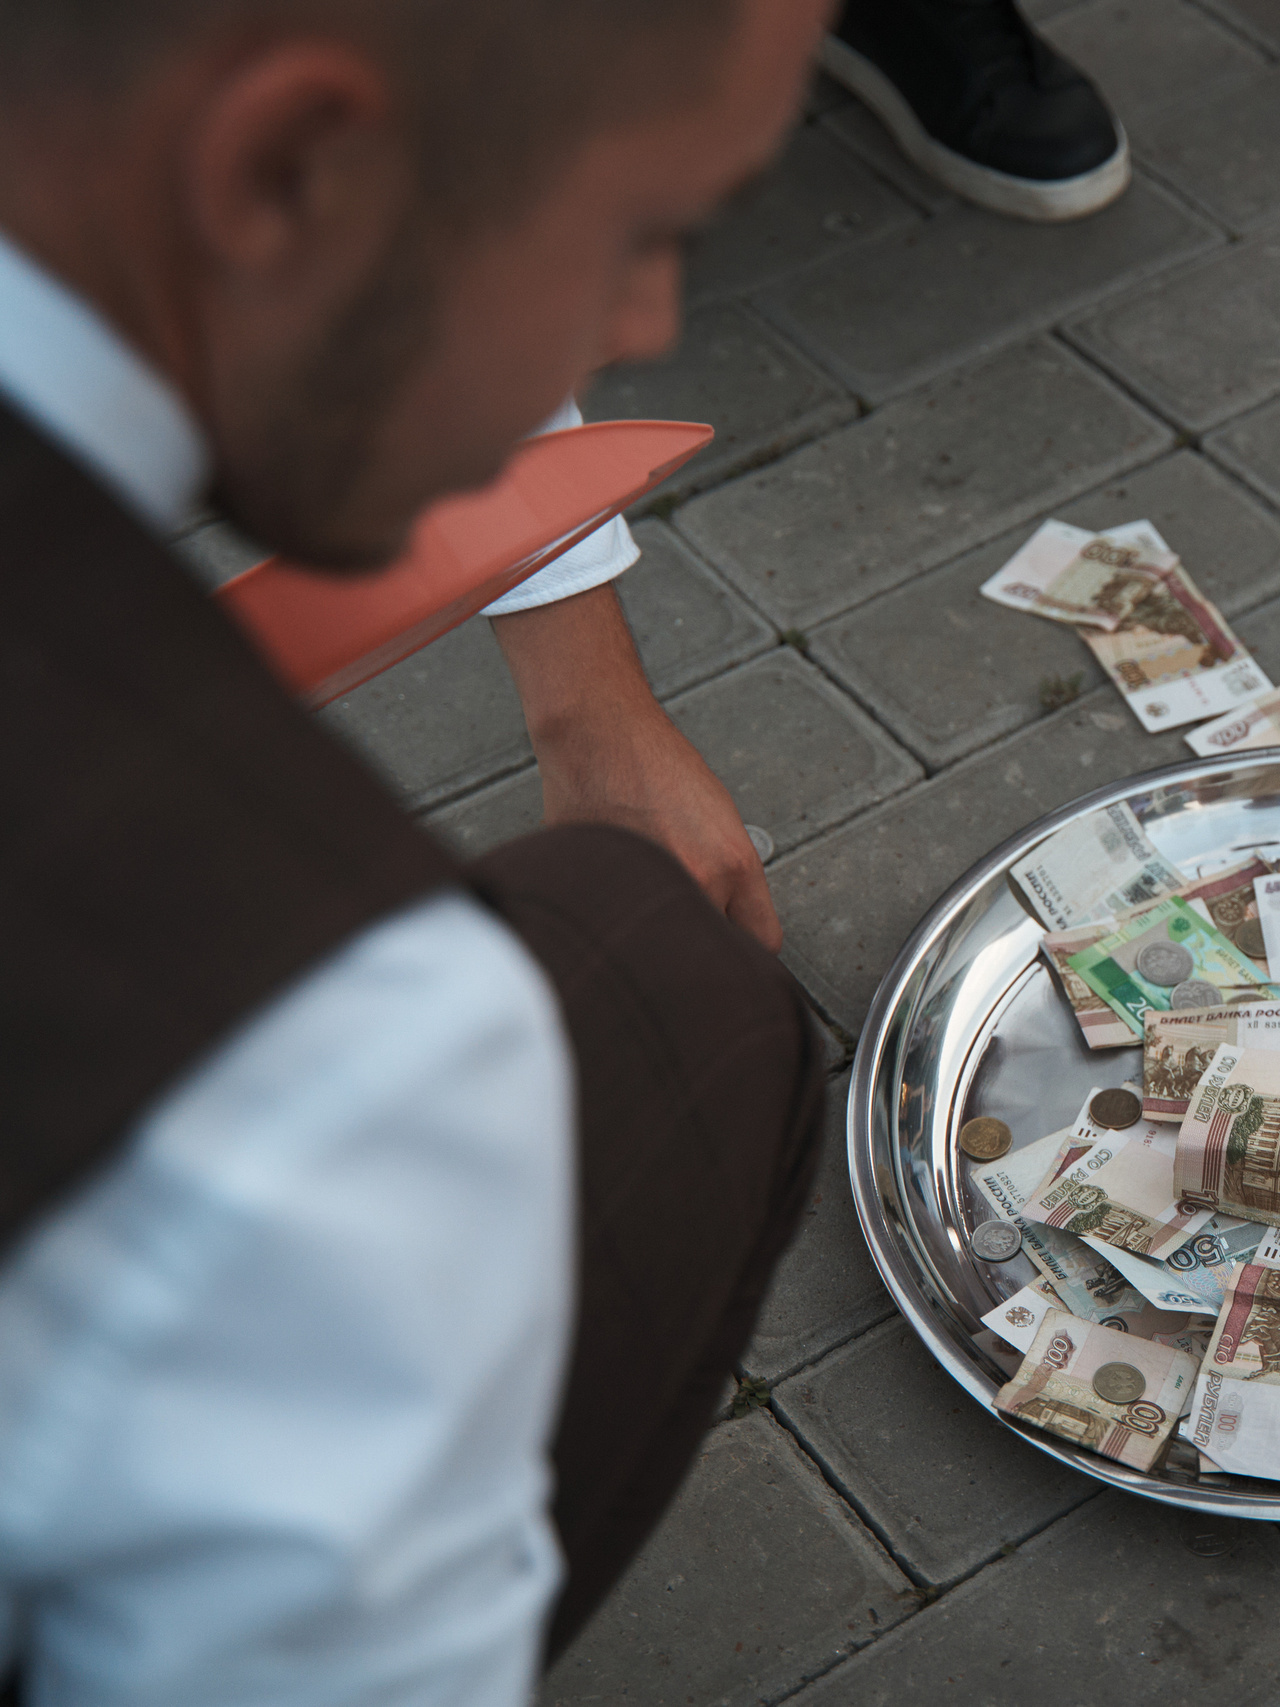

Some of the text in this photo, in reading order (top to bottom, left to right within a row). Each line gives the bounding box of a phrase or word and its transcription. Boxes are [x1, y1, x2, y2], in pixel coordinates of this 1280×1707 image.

[1211, 720, 1249, 745] 100
[1025, 870, 1059, 919] РОССИИ
[1207, 1009, 1251, 1023] БАНКА
[1194, 1055, 1238, 1123] СТО РУБЛЕЙ
[996, 1170, 1025, 1205] 5770827
[1038, 1148, 1113, 1211] СТО РУБЛЕЙ
[983, 1175, 1070, 1281] БИЛЕТ БАНКА РОССИИ
[1165, 1232, 1228, 1272] 50
[1042, 1336, 1071, 1369] 100
[1193, 1333, 1234, 1447] СТО РУБЛЕЙ
[1113, 1399, 1166, 1439] 100
[1217, 1412, 1239, 1433] 100
